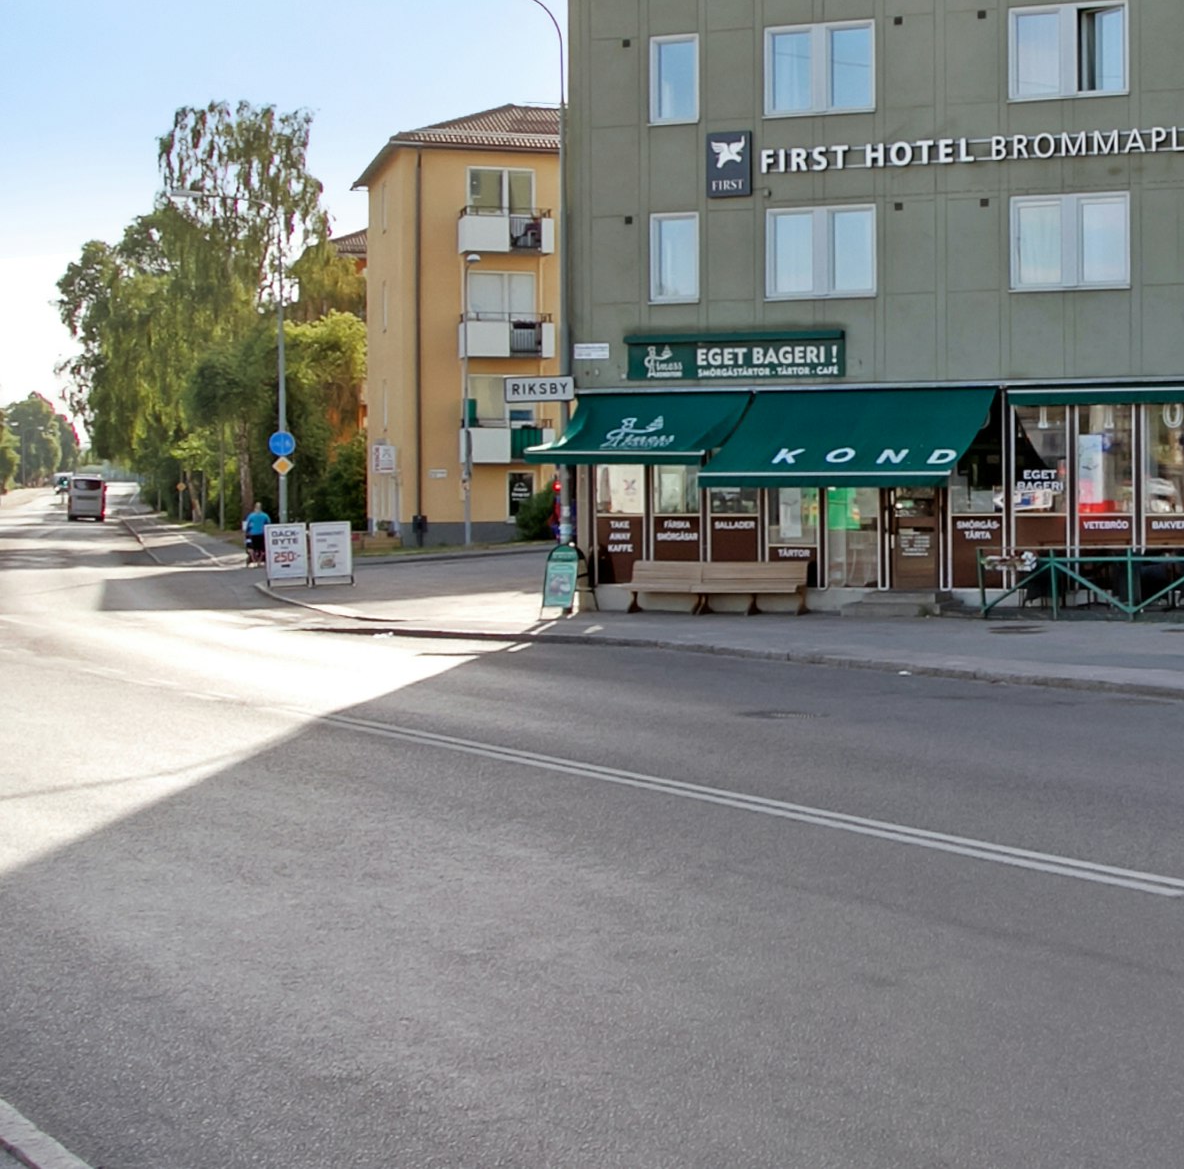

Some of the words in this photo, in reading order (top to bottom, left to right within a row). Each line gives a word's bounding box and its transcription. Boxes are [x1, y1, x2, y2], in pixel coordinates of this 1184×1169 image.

[761, 145, 849, 174] FIRST
[865, 137, 975, 168] HOTEL
[711, 179, 745, 191] FIRST
[696, 347, 747, 366] EGET
[752, 345, 826, 364] BAGERI
[816, 364, 839, 375] CAFÉ
[511, 382, 568, 395] RIKSBY
[1023, 469, 1057, 480] EGET
[1016, 481, 1064, 491] BAGERI
[610, 520, 630, 529] TAKE
[714, 520, 756, 529] SALLADER
[1083, 519, 1129, 529] VETEBRÖD
[609, 532, 631, 541] AWAY
[608, 544, 634, 553] KAFFE
[778, 547, 810, 558] TÅRTOR
